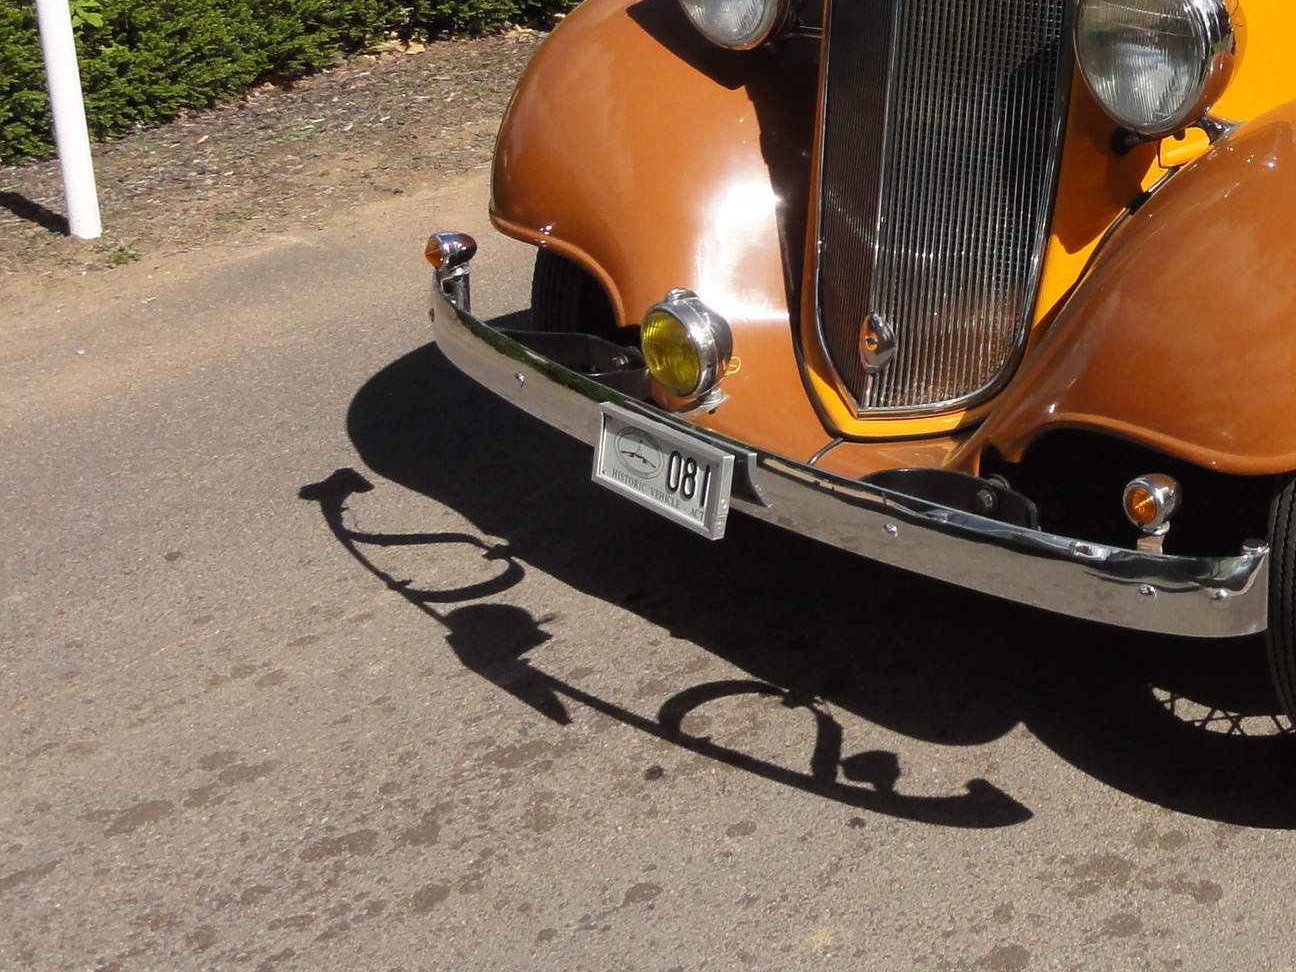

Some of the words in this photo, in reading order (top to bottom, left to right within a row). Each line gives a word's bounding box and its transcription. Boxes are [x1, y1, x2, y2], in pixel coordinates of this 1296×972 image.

[612, 468, 647, 491] HISTORIC
[650, 486, 680, 508] VEHICLE
[690, 508, 705, 521] ACT
[667, 450, 711, 508] 081
